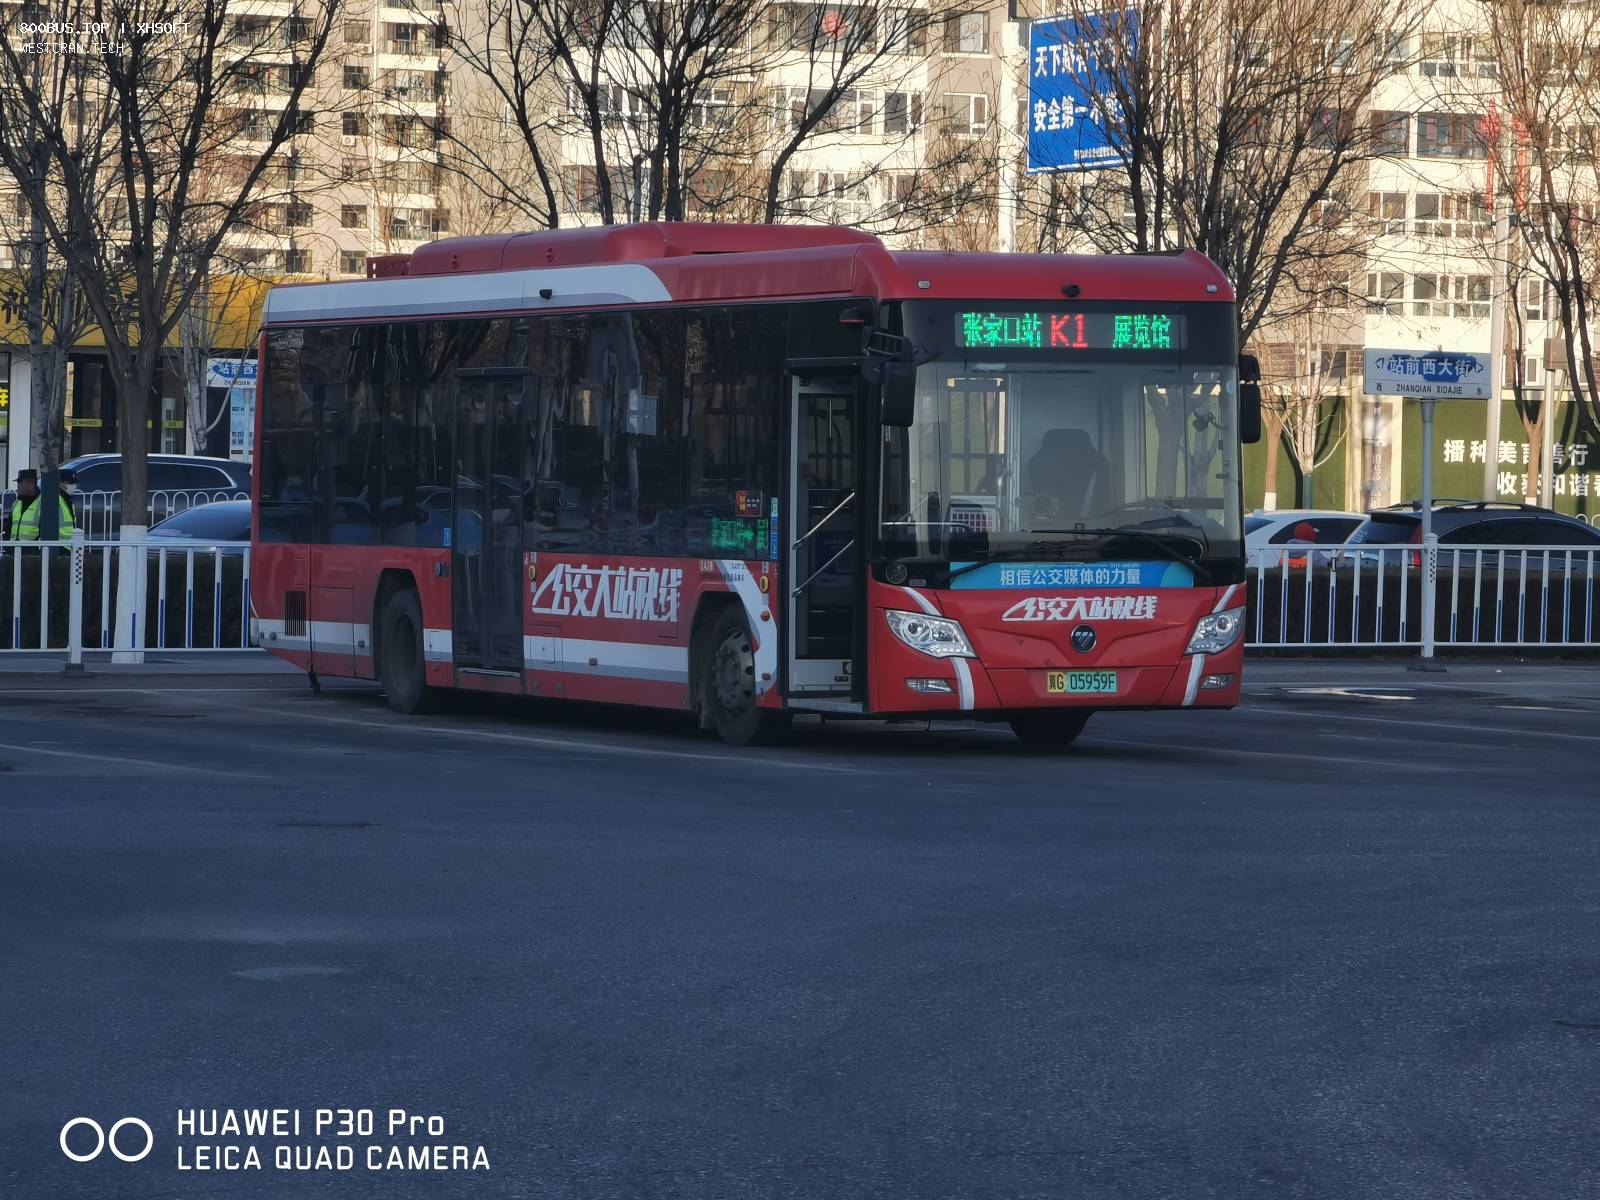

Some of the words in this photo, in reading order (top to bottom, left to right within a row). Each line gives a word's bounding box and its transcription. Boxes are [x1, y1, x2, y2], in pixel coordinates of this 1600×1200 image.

[962, 312, 1042, 348] 张家口站
[1049, 313, 1088, 348] K1
[1112, 314, 1171, 349] 展览馆
[1389, 357, 1471, 377] 站前西大街
[1396, 383, 1432, 393] ZHANQIAN
[1436, 385, 1463, 394] XIDAJIE
[1000, 568, 1142, 586] 相信公交媒体的力量
[531, 563, 683, 623] 公交大站快线
[1001, 595, 1158, 622] 公交大站快线
